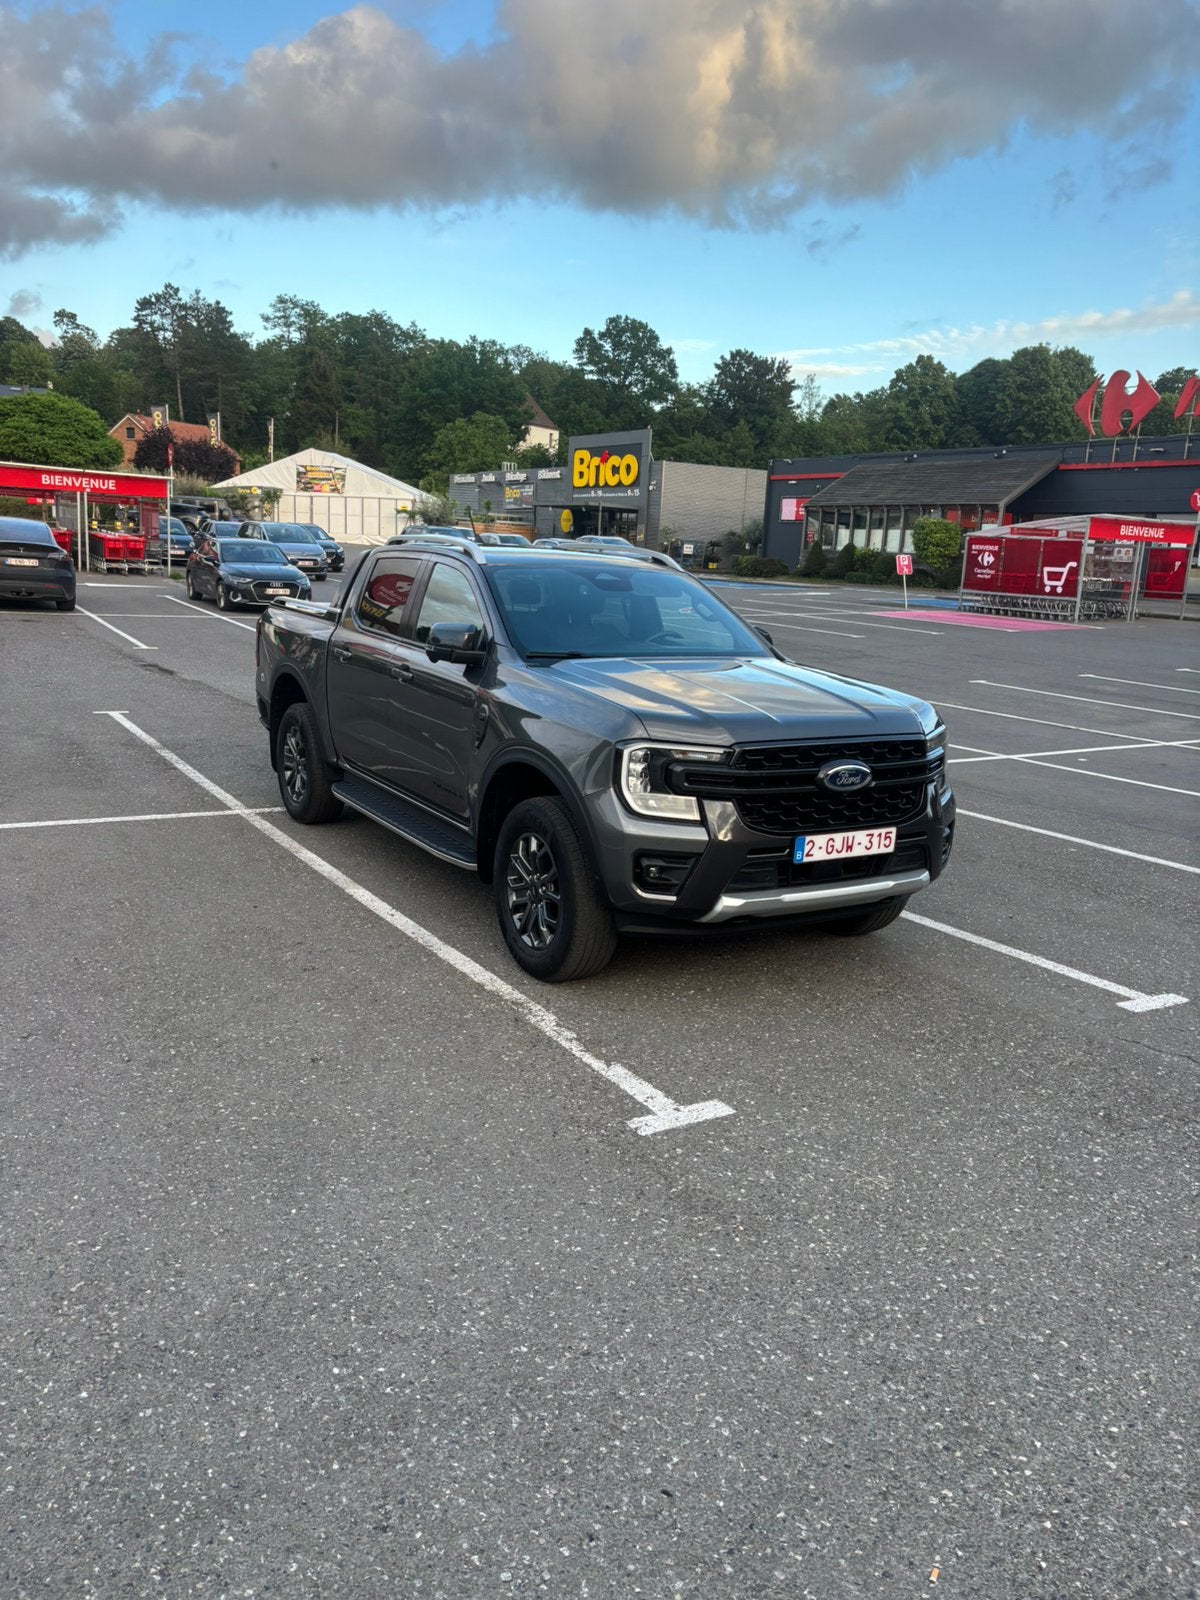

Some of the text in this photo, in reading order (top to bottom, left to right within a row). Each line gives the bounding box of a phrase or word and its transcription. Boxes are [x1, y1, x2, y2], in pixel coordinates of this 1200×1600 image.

[573, 449, 639, 488] Brico
[41, 474, 117, 490] BIENVENUE
[505, 486, 521, 498] Brico
[1120, 525, 1166, 539] BIENVENUE
[836, 770, 862, 786] Ford
[796, 831, 893, 860] B 2-GJW-315
